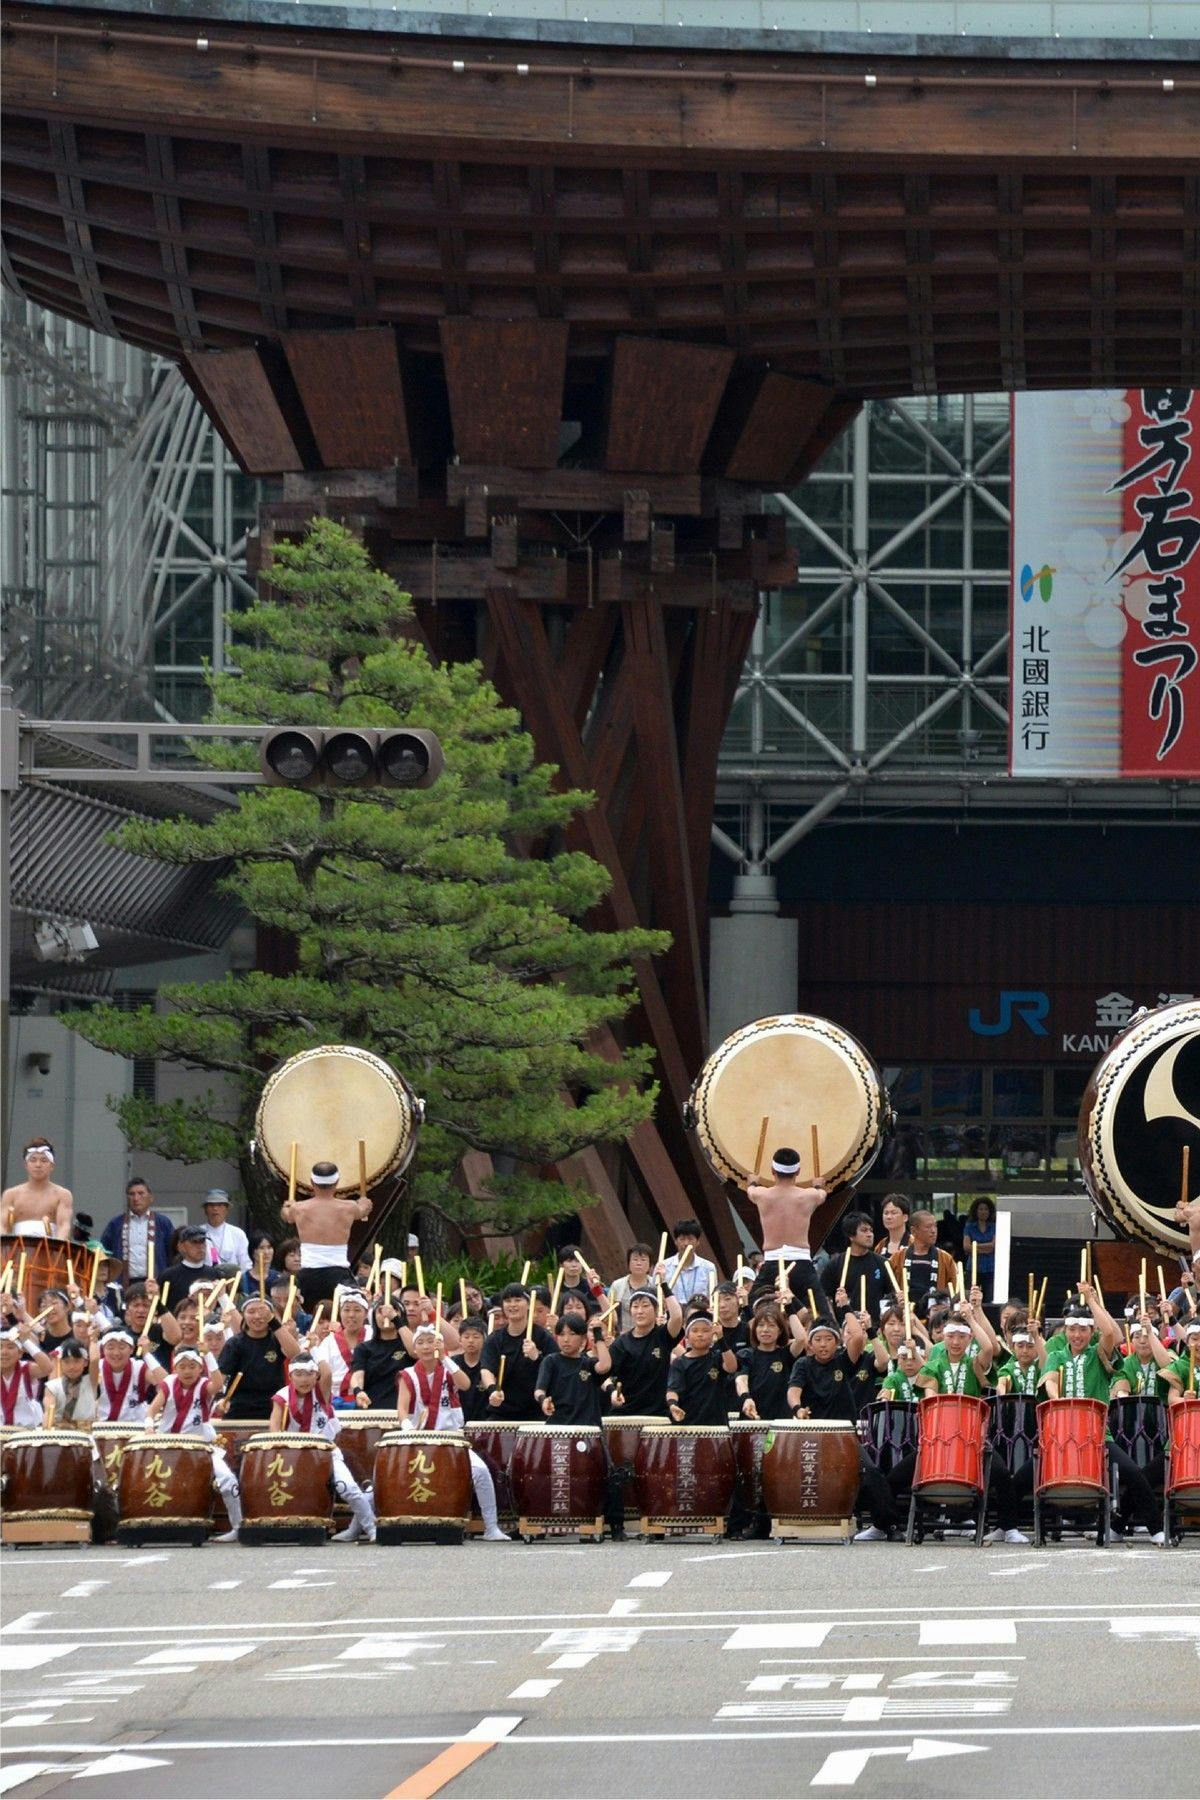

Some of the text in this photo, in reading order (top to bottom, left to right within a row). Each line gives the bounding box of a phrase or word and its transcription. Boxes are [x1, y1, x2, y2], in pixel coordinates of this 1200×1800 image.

[1021, 624, 1051, 750] 北國銀行
[968, 990, 1051, 1036] JR
[142, 1453, 173, 1508] 九谷
[266, 1452, 295, 1507] 九谷
[407, 1449, 437, 1503] 九谷
